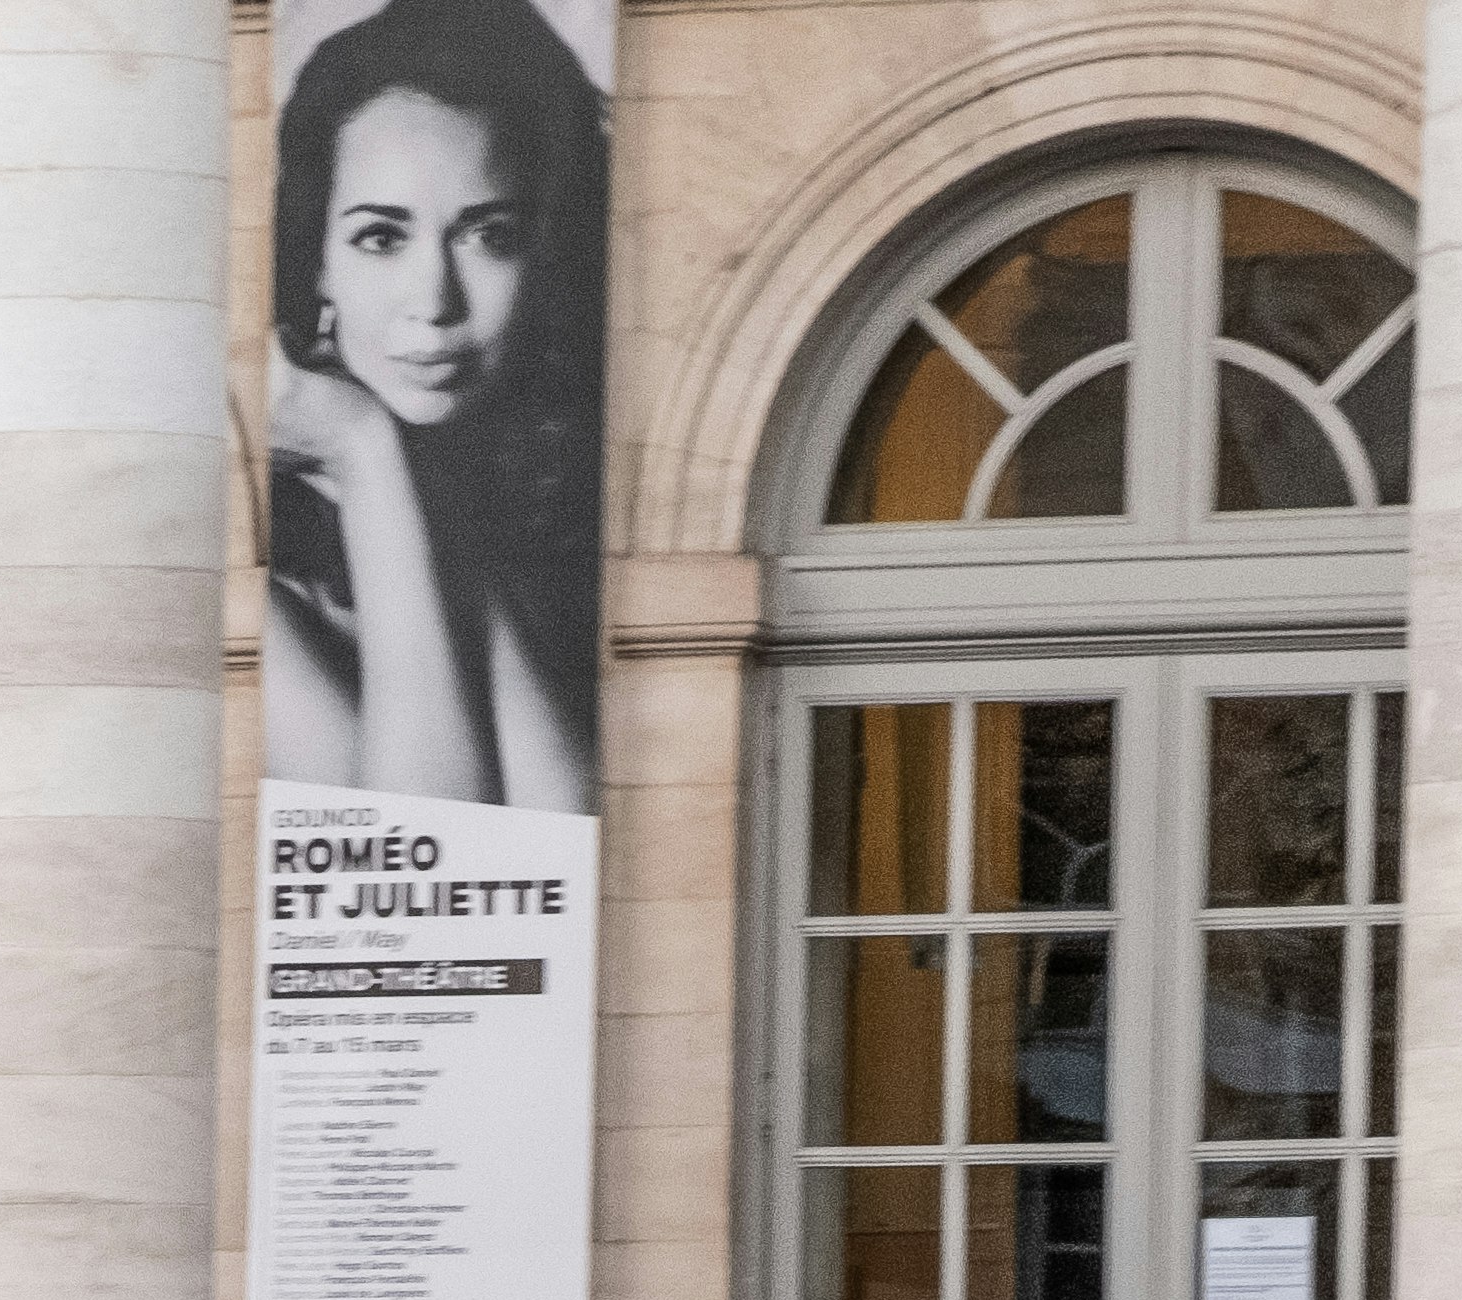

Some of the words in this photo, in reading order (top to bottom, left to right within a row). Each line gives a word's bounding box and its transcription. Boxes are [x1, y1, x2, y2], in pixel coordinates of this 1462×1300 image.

[273, 825, 443, 874] ROMÉO
[273, 884, 329, 919] ET
[338, 878, 565, 918] JULIETTE
